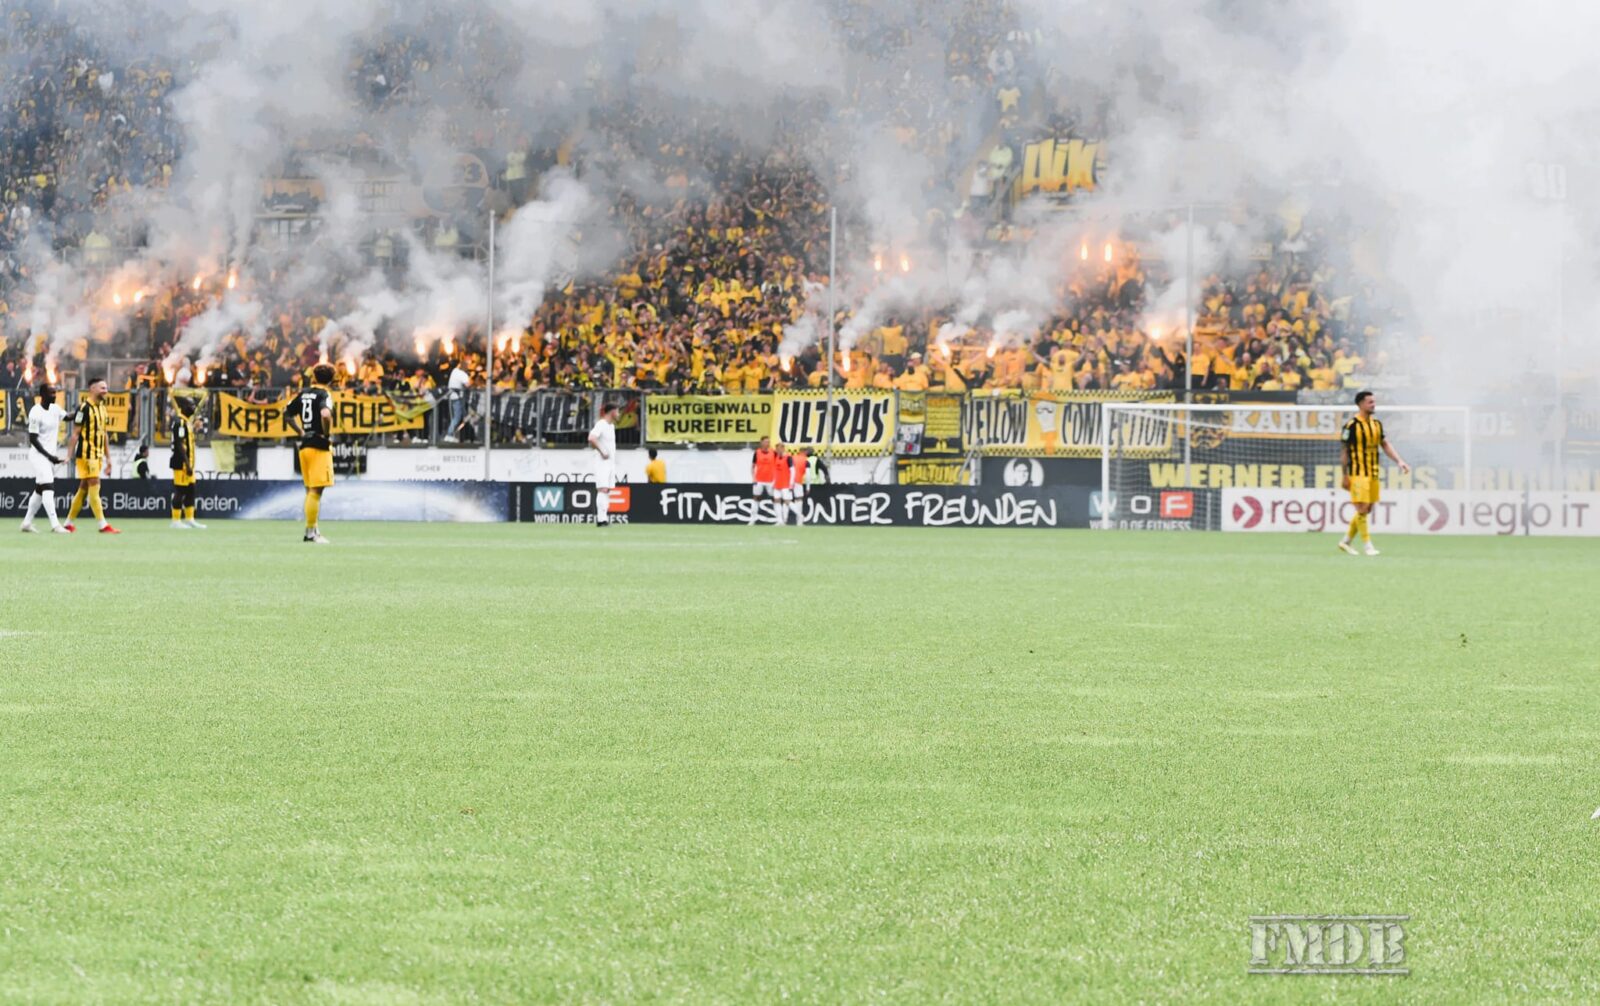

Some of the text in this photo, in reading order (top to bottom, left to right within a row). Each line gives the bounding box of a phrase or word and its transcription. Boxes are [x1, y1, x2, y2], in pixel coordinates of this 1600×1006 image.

[648, 400, 772, 416] HÜRTGENWALD
[779, 398, 889, 443] ULTRAS
[663, 419, 758, 434] RUREIFEL
[963, 400, 1028, 445] YELLOW
[1230, 409, 1336, 434] KARLS
[1148, 462, 1305, 489] WERNER
[113, 491, 166, 510] Blauen
[660, 488, 778, 524] FITNESS
[904, 491, 1058, 526] FREUNDEN
